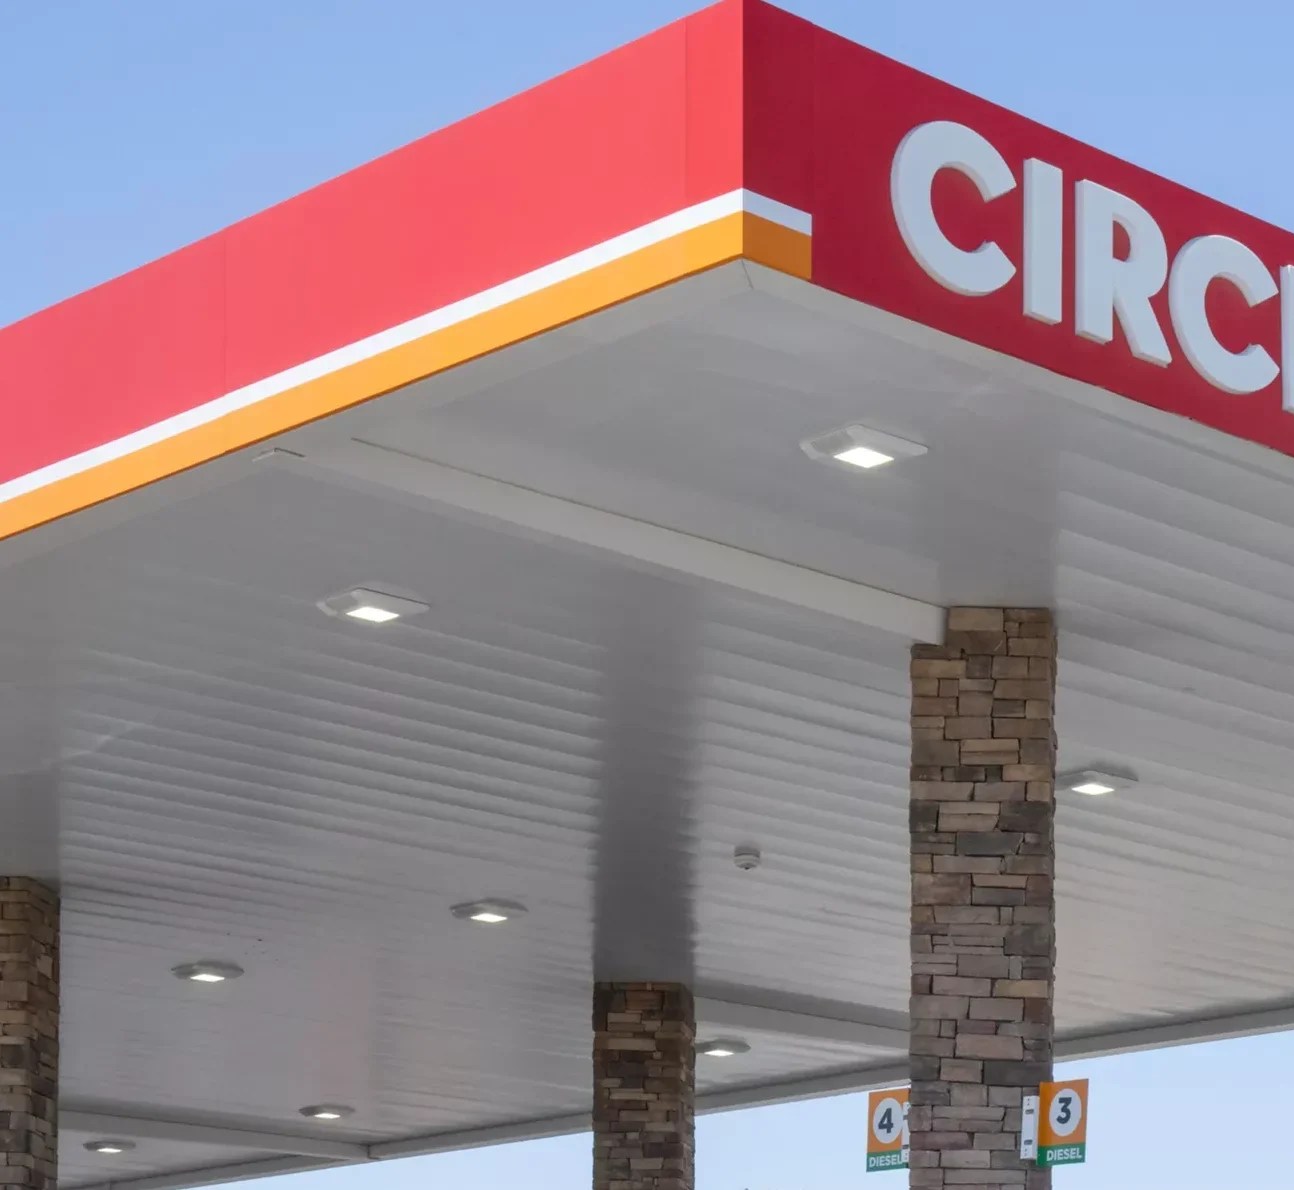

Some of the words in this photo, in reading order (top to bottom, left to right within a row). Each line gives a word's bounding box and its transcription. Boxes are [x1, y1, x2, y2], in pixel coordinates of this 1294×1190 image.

[878, 1107, 894, 1134] 4
[1056, 1096, 1072, 1125] 3
[868, 1154, 902, 1168] DIESEL
[1046, 1147, 1082, 1162] DIESEL
